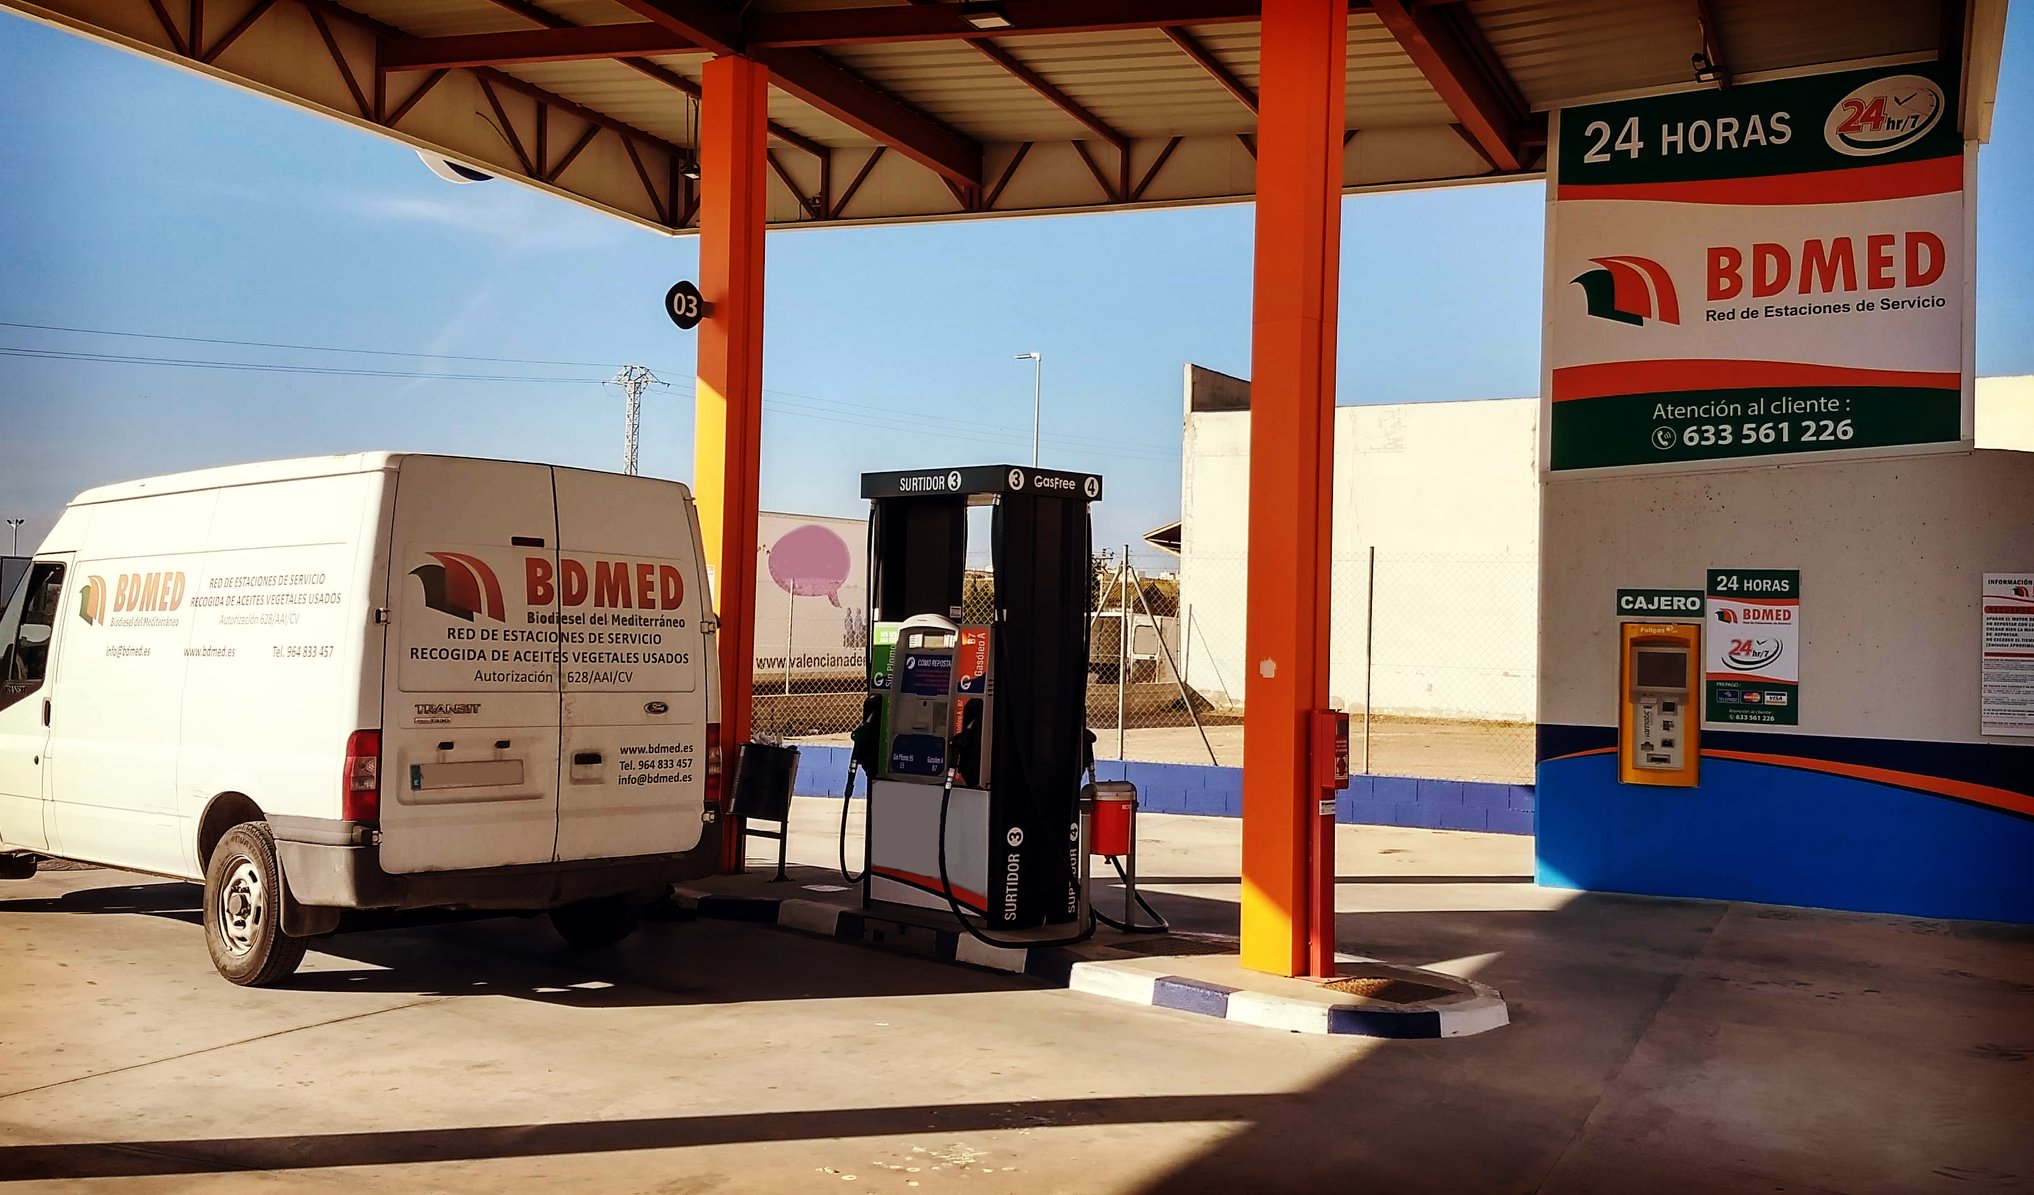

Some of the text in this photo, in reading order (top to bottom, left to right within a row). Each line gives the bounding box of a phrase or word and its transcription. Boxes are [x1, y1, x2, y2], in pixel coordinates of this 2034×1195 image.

[1583, 111, 1792, 164] 24 HORAS
[1706, 231, 1947, 302] BDMED
[673, 292, 698, 318] 03
[1706, 295, 1946, 322] Red de Estaciones de Servicio
[1652, 400, 1742, 420] Atención
[1747, 398, 1764, 416] al
[1770, 396, 1840, 415] cliente
[1682, 419, 1854, 447] 633 561 226
[899, 471, 960, 492] SURTIDOR 3
[1012, 470, 1022, 488] 3
[1034, 475, 1076, 490] GasFree
[1087, 478, 1097, 496] 4
[208, 573, 326, 589] RED DE ESTACIONES DE SERVICIO
[525, 556, 685, 611] BDMED
[1716, 575, 1790, 592] 24 HORAS
[113, 572, 186, 612] BDMED
[190, 592, 342, 607] RECOGIDA DE ACEITES VEGETALES USADOS
[1620, 595, 1701, 610] CAJERO
[110, 617, 133, 627] Biodiesel
[527, 611, 686, 628] Biodiesel del Mediterráneo
[1742, 608, 1792, 621] BDMED
[447, 627, 662, 645] RED DE ESTACIONES DE SERVICIO
[967, 632, 977, 645] B7
[106, 645, 151, 658] info@bdmed.es
[183, 645, 235, 657] www.bdmed.es
[272, 645, 334, 658] Tel. 964 833 457
[410, 647, 689, 665] RECOGIDA DE ACEITES VEGETALES USADOS
[973, 632, 986, 677] Gasóleo A
[473, 669, 633, 684] Autorización 628/AAI/CV
[414, 703, 482, 715] TRANSIT
[619, 743, 694, 755] www.bdmed.es
[619, 758, 693, 771] Tel. 964 833 457
[618, 772, 693, 786] info@bdmed.es
[1004, 853, 1020, 921] SURTIDOR
